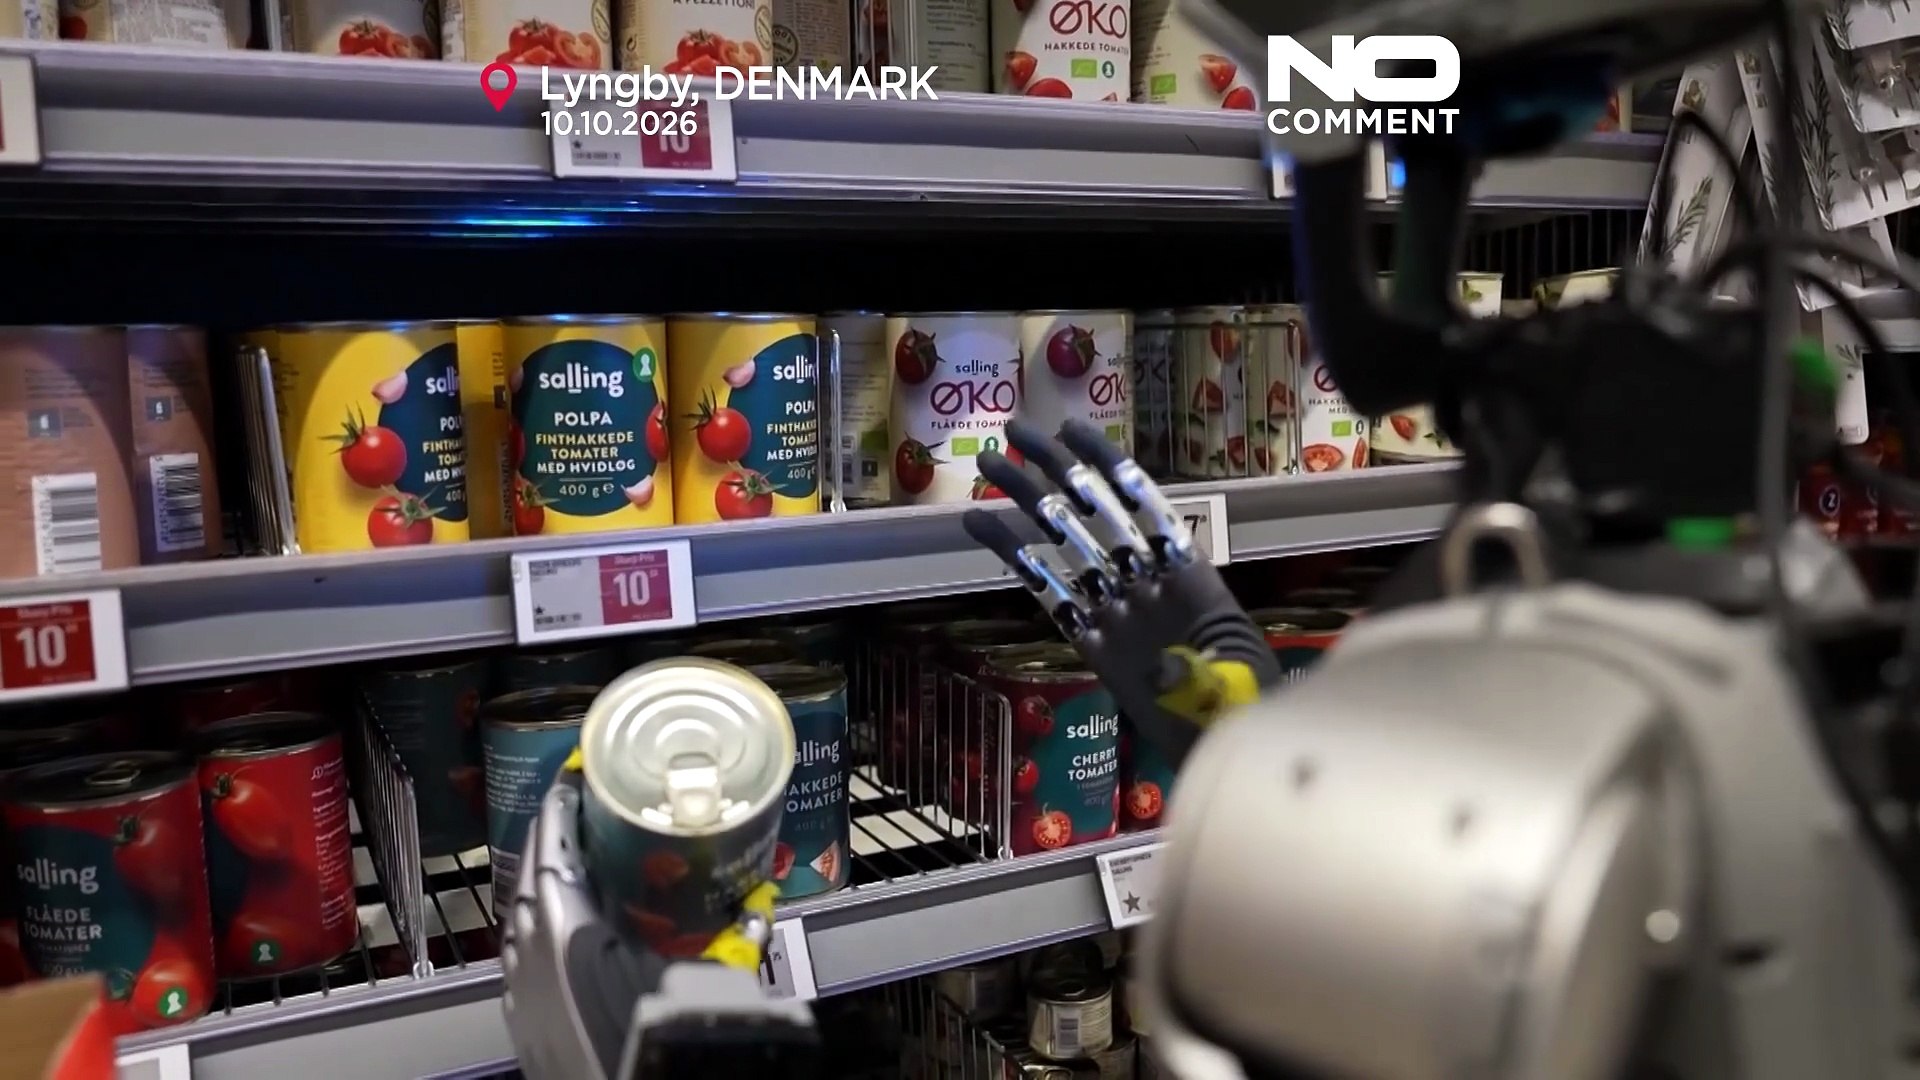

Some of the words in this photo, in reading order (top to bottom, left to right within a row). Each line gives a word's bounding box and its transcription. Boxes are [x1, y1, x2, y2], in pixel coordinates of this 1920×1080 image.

[1049, 0, 1127, 38] ØKO
[1044, 42, 1096, 51] HAKKEDE
[955, 360, 999, 378] salling
[539, 363, 624, 397] salling
[1089, 372, 1127, 406] ØK
[930, 380, 1016, 415] ØKO
[554, 411, 613, 426] POLPA
[931, 419, 971, 429] FLÅEDE
[535, 431, 635, 445] FINTHAKKEDE
[551, 447, 619, 460] TOMATER
[766, 450, 793, 461] MED
[537, 462, 566, 474] MED
[569, 459, 636, 473] HVIDLØG
[788, 468, 806, 479] 400
[424, 469, 449, 483] MED
[559, 484, 587, 496] 400
[592, 487, 600, 499] g
[613, 570, 651, 607] 10
[16, 625, 67, 669] 10
[1066, 714, 1118, 739] salling
[1072, 746, 1116, 767] CHERRY
[17, 858, 99, 894] salling
[26, 903, 91, 922] FLÅEDE
[23, 921, 102, 940] TOMATER
